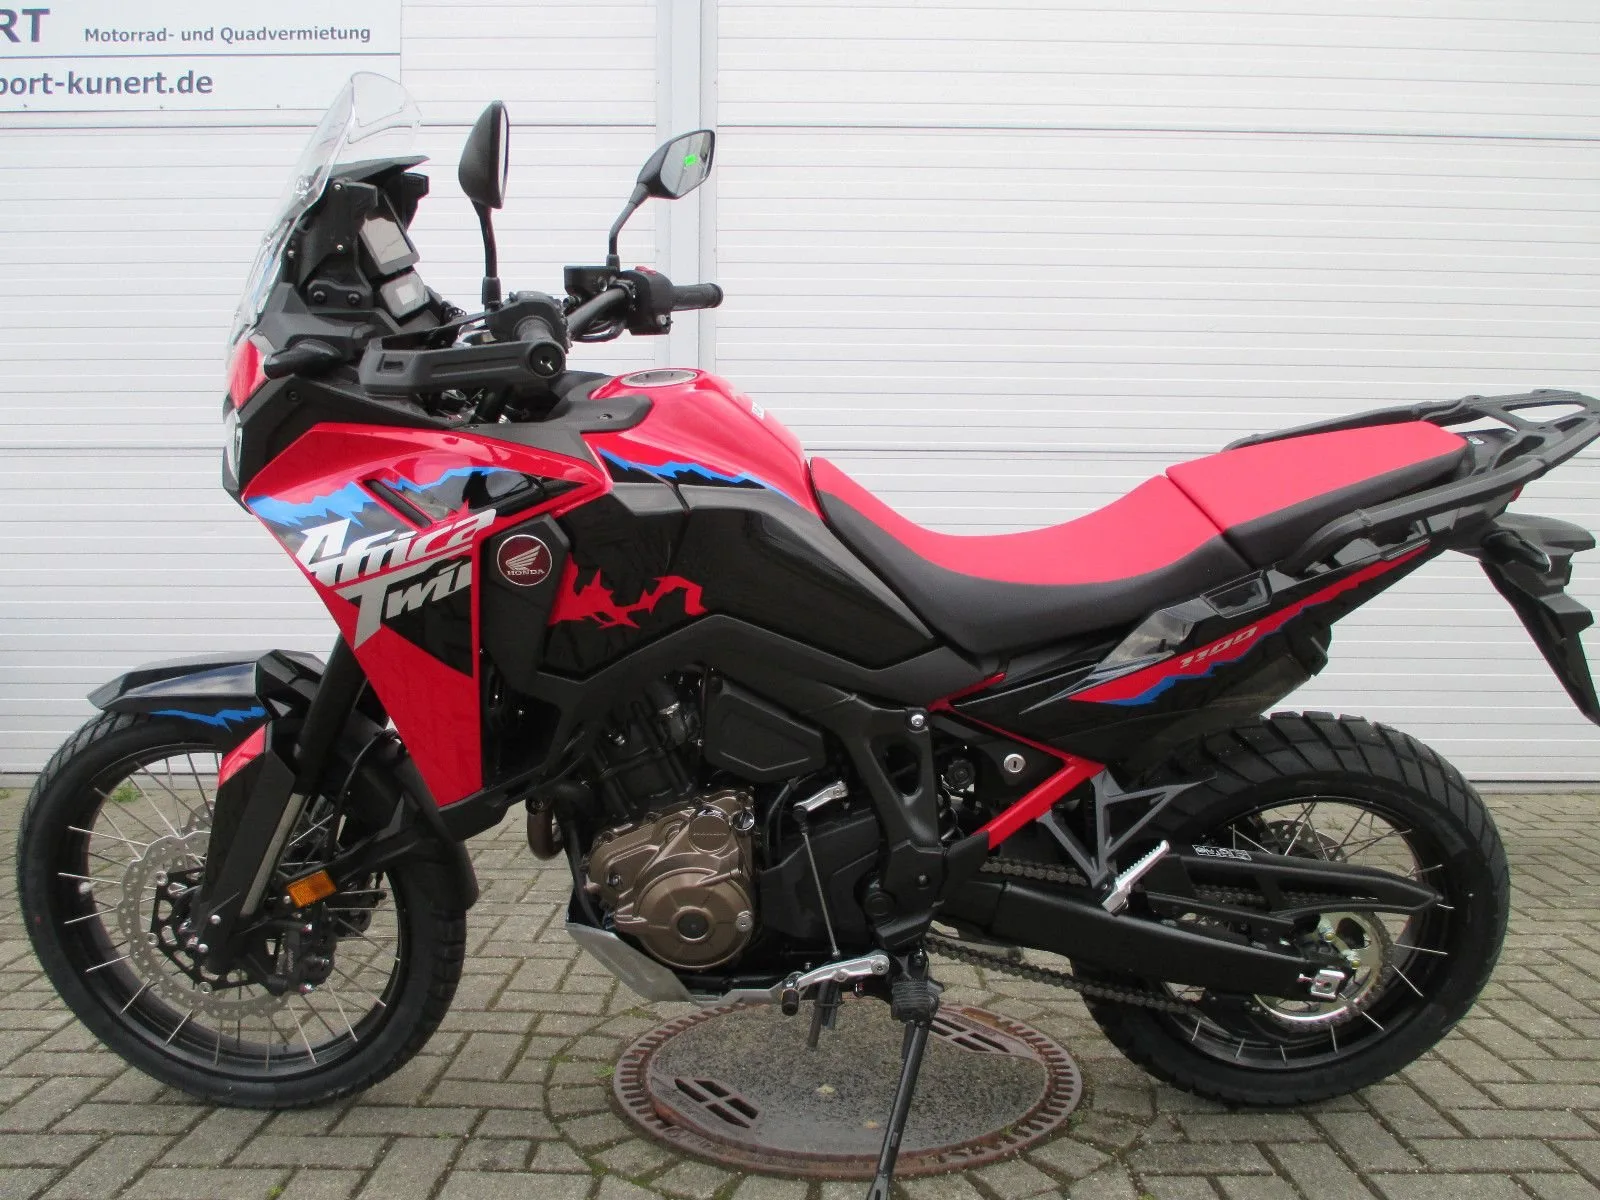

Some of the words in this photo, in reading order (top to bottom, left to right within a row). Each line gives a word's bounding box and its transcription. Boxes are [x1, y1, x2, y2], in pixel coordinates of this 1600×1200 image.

[85, 27, 174, 42] Motorrad-
[181, 27, 214, 42] und
[220, 26, 371, 44] Quadvermietung
[295, 508, 496, 587] Africa
[1179, 626, 1258, 669] 1100
